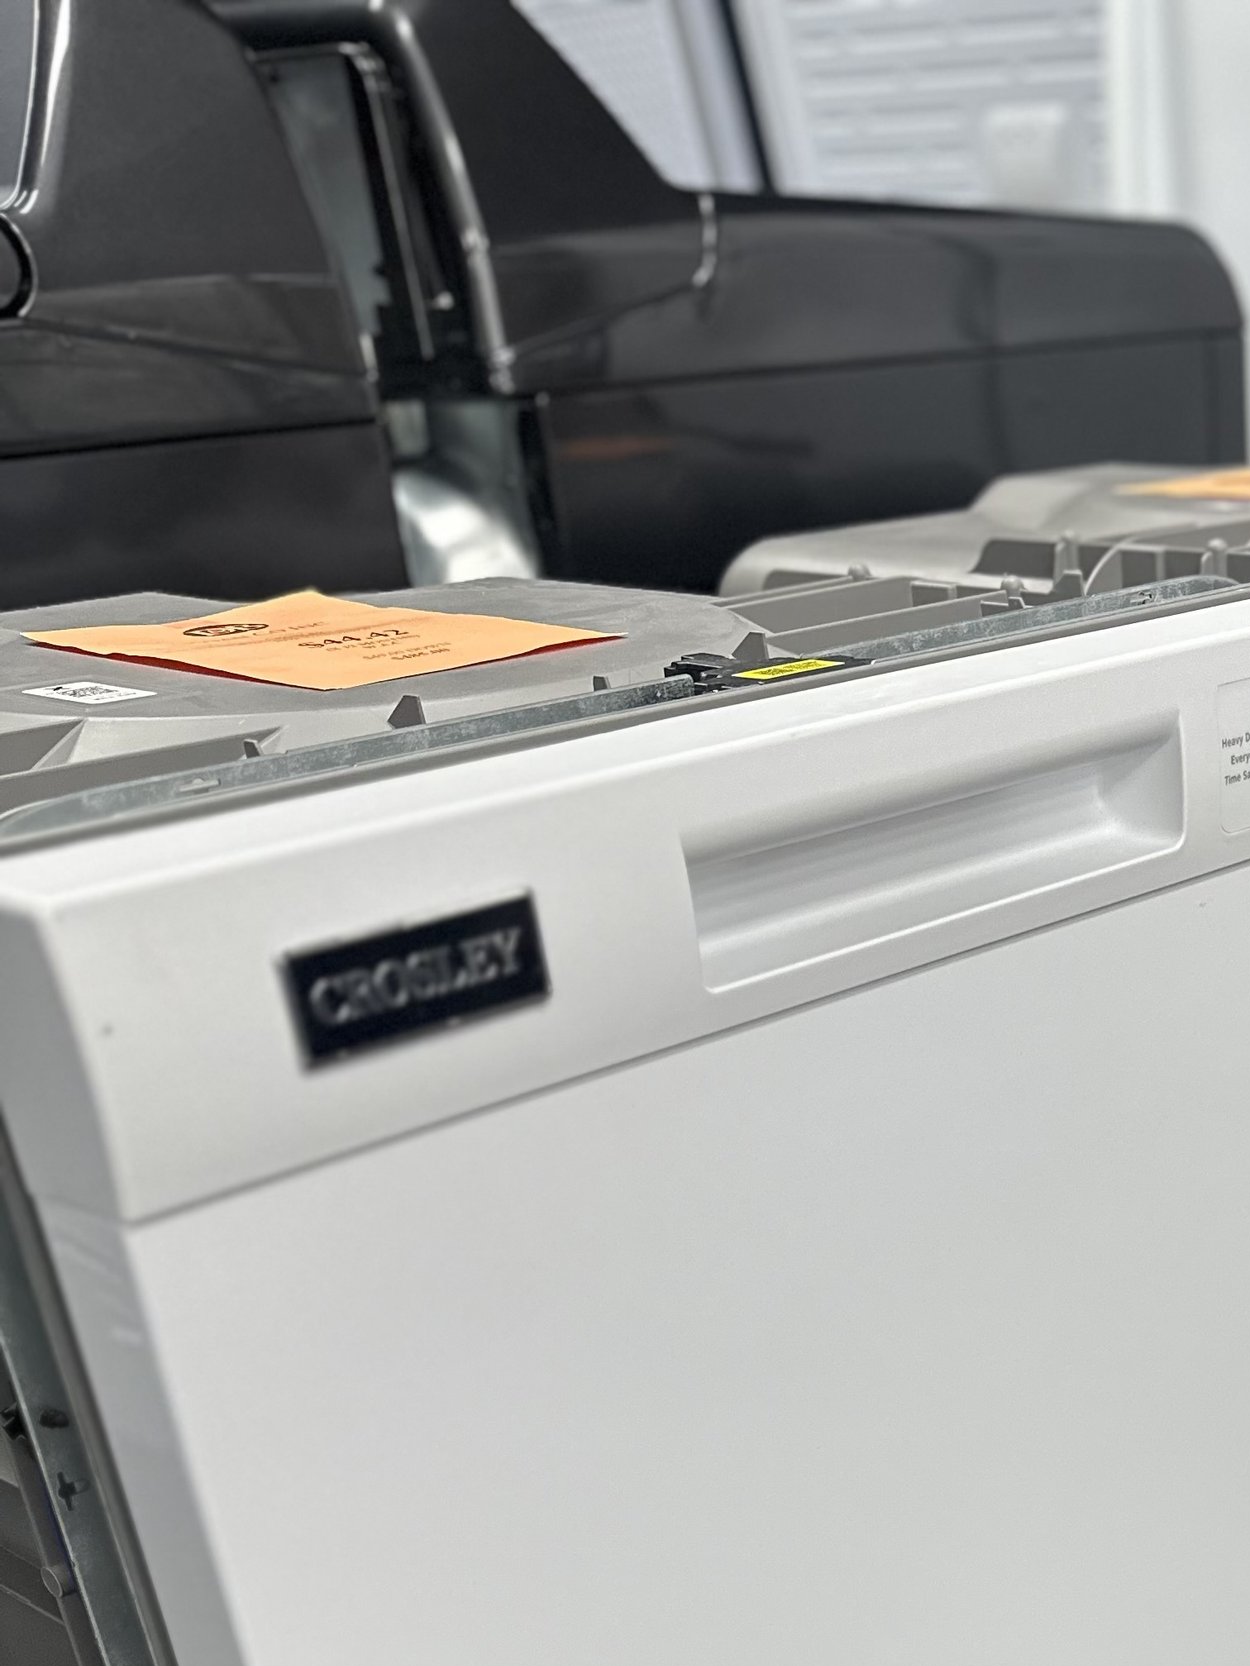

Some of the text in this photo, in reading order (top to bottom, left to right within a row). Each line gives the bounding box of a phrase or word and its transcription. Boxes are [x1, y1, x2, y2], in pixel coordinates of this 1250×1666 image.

[1222, 736, 1243, 748] Heavy
[1224, 774, 1242, 786] Time
[310, 927, 521, 1023] CROSLEY
